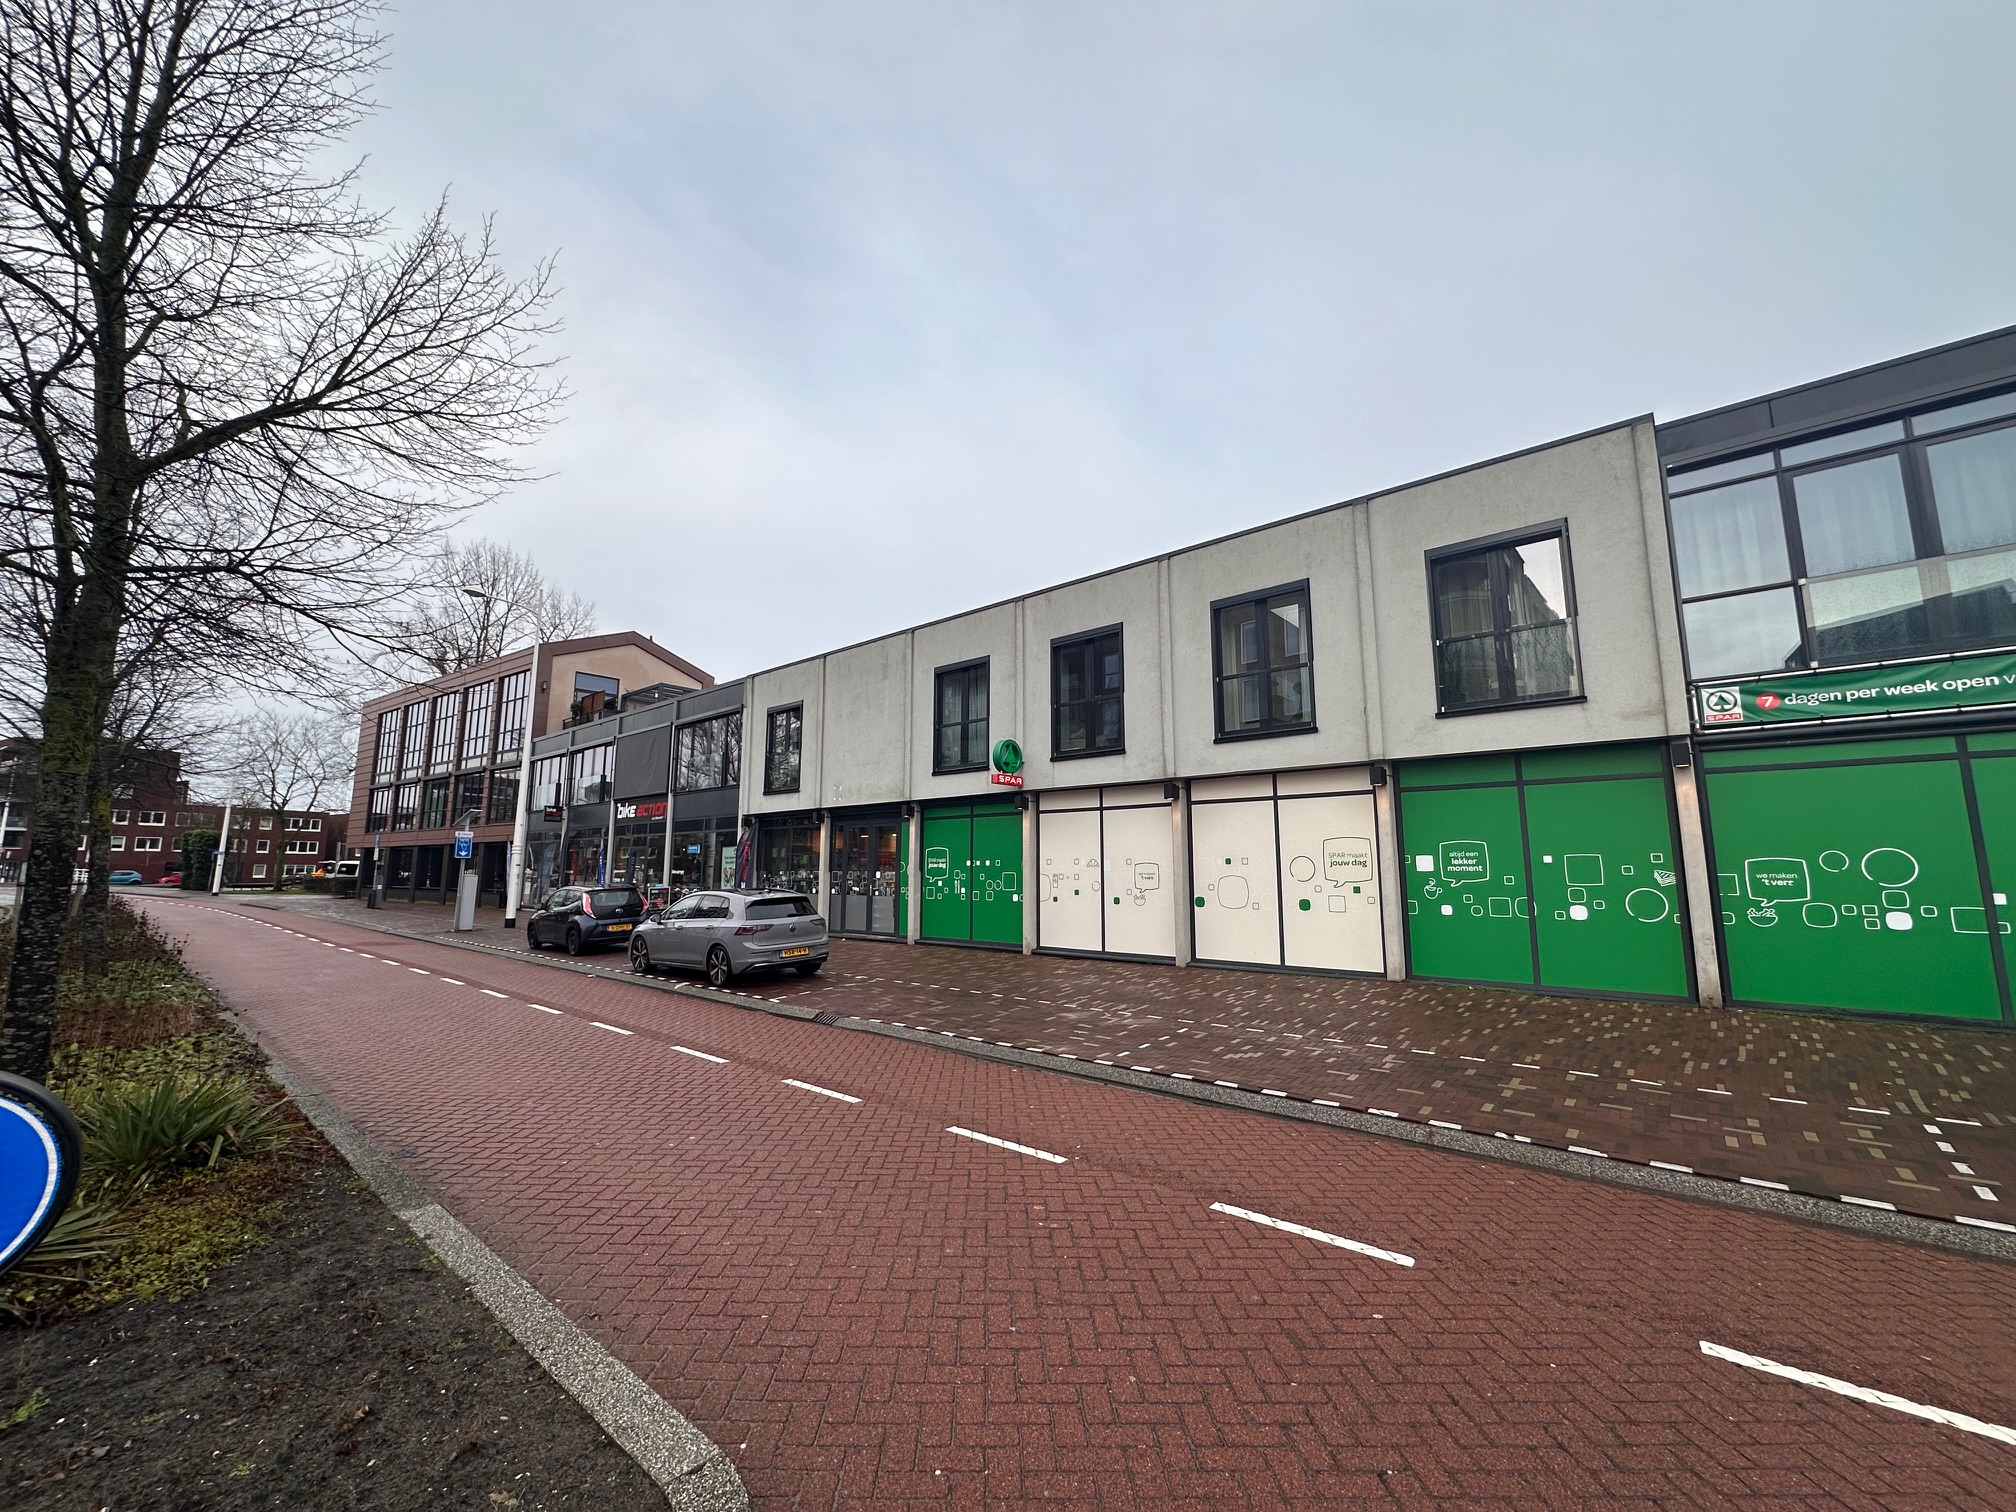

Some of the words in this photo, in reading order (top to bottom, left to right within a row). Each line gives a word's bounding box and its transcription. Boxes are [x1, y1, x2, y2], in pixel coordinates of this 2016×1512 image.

[1760, 696, 1774, 708] 7
[1784, 691, 1842, 706] dagen
[1845, 687, 1880, 702] per
[1883, 679, 1939, 696] week
[1942, 675, 2000, 692] open
[1707, 713, 1740, 721] SPAR
[998, 775, 1022, 785] SPAR
[1329, 859, 1350, 868] jouw
[1351, 859, 1367, 868] dag
